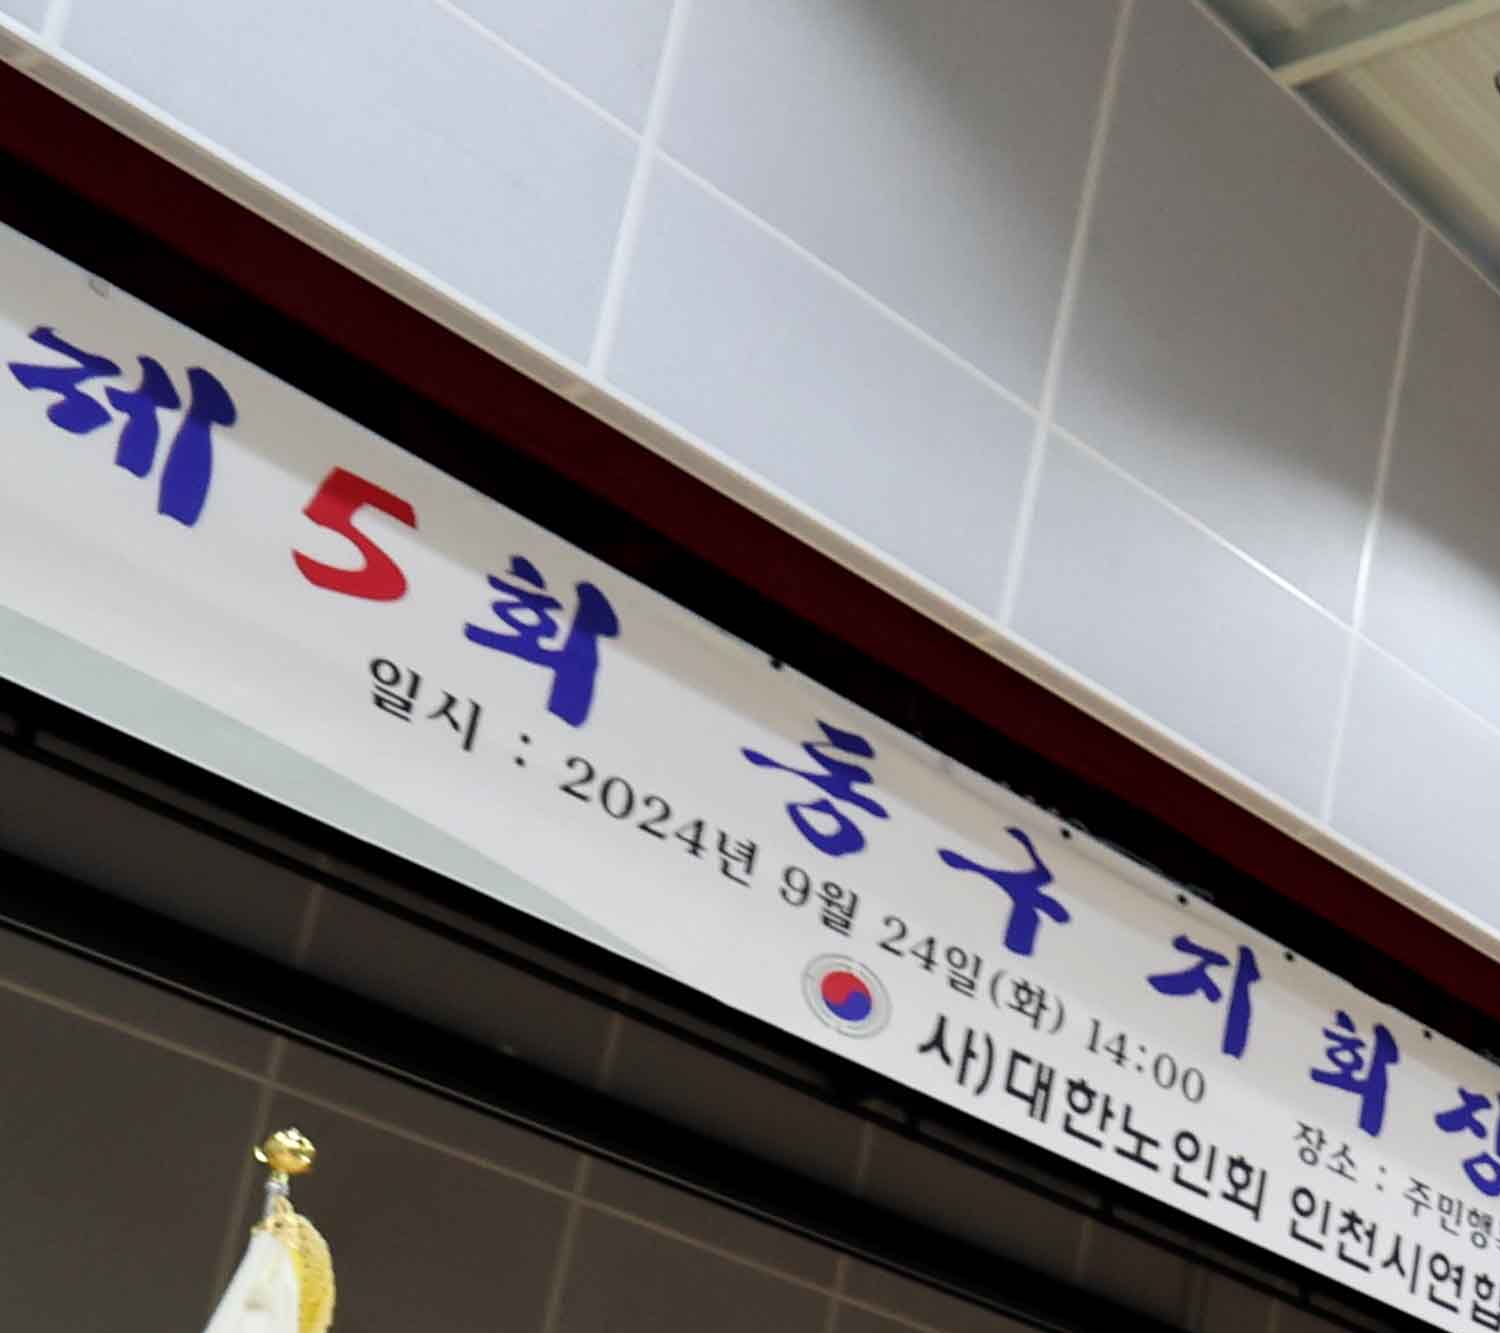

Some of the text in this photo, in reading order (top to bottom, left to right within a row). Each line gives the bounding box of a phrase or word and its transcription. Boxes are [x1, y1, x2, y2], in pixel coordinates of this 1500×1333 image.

[369, 657, 483, 752] 일시
[559, 756, 758, 888] 2024년
[779, 865, 860, 937] 9월
[877, 914, 1067, 1036] 24일(화)
[1085, 1018, 1207, 1104] 14:00
[1293, 1121, 1360, 1183] 장소
